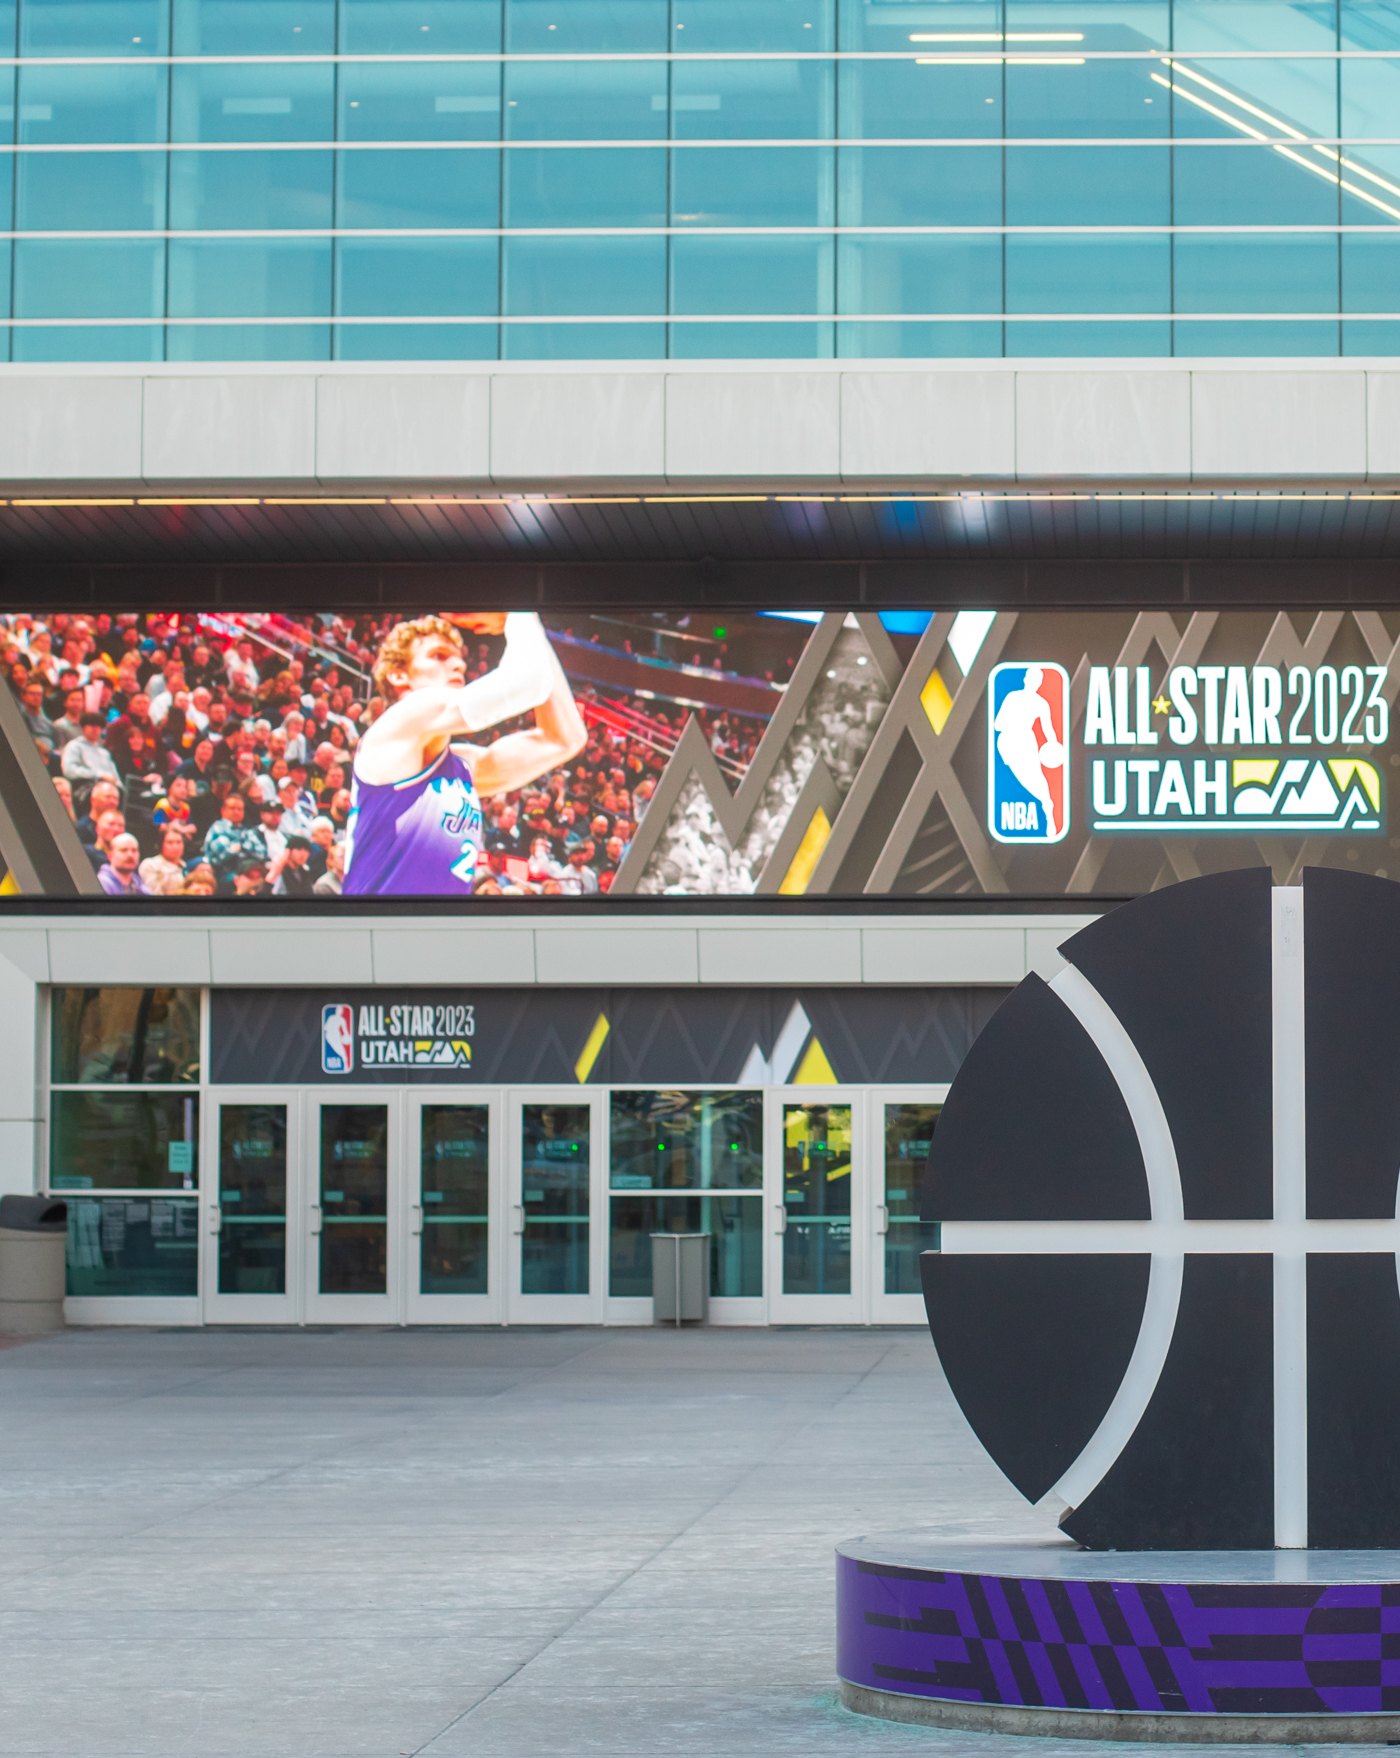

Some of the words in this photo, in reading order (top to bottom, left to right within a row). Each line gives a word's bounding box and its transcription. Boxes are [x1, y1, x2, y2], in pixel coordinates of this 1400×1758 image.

[1288, 666, 1389, 745] 2023
[1092, 759, 1229, 816] UTAH
[1001, 802, 1039, 831] NBA
[435, 1005, 475, 1036] 2023
[326, 1057, 342, 1069] NBA
[361, 1040, 414, 1063] UTAH
